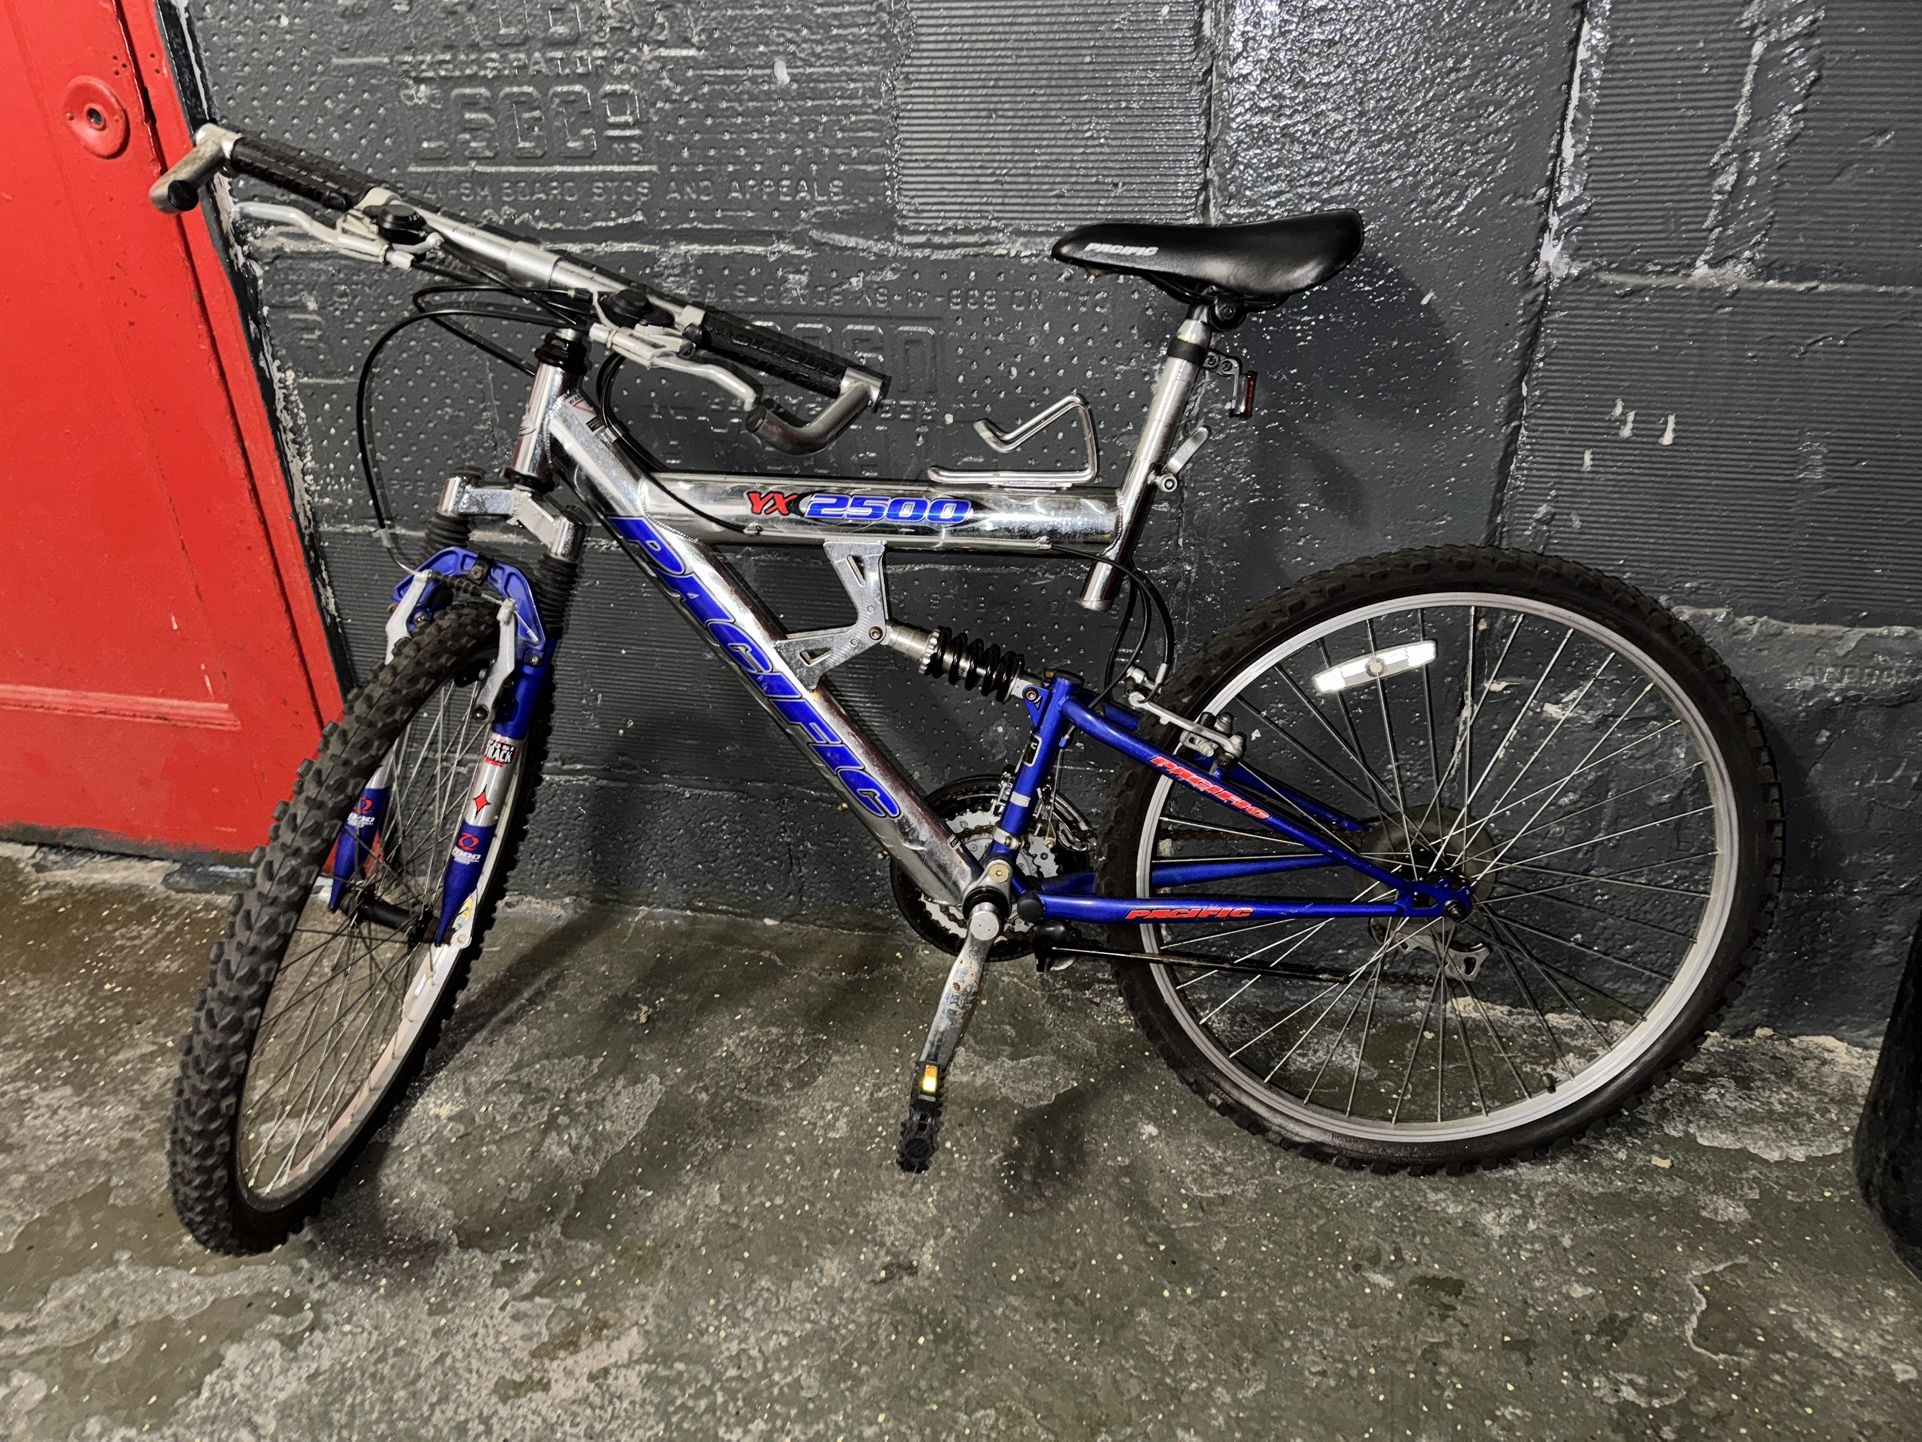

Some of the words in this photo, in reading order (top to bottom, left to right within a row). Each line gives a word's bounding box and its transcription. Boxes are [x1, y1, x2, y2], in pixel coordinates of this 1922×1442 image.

[666, 180, 713, 201] AND
[728, 179, 844, 201] APPEALS
[746, 491, 798, 516] YX
[803, 492, 972, 525] 2500
[607, 515, 901, 818] PACIFIC
[1150, 755, 1272, 821] PACIFIC
[1125, 907, 1255, 921] PACIFIC
